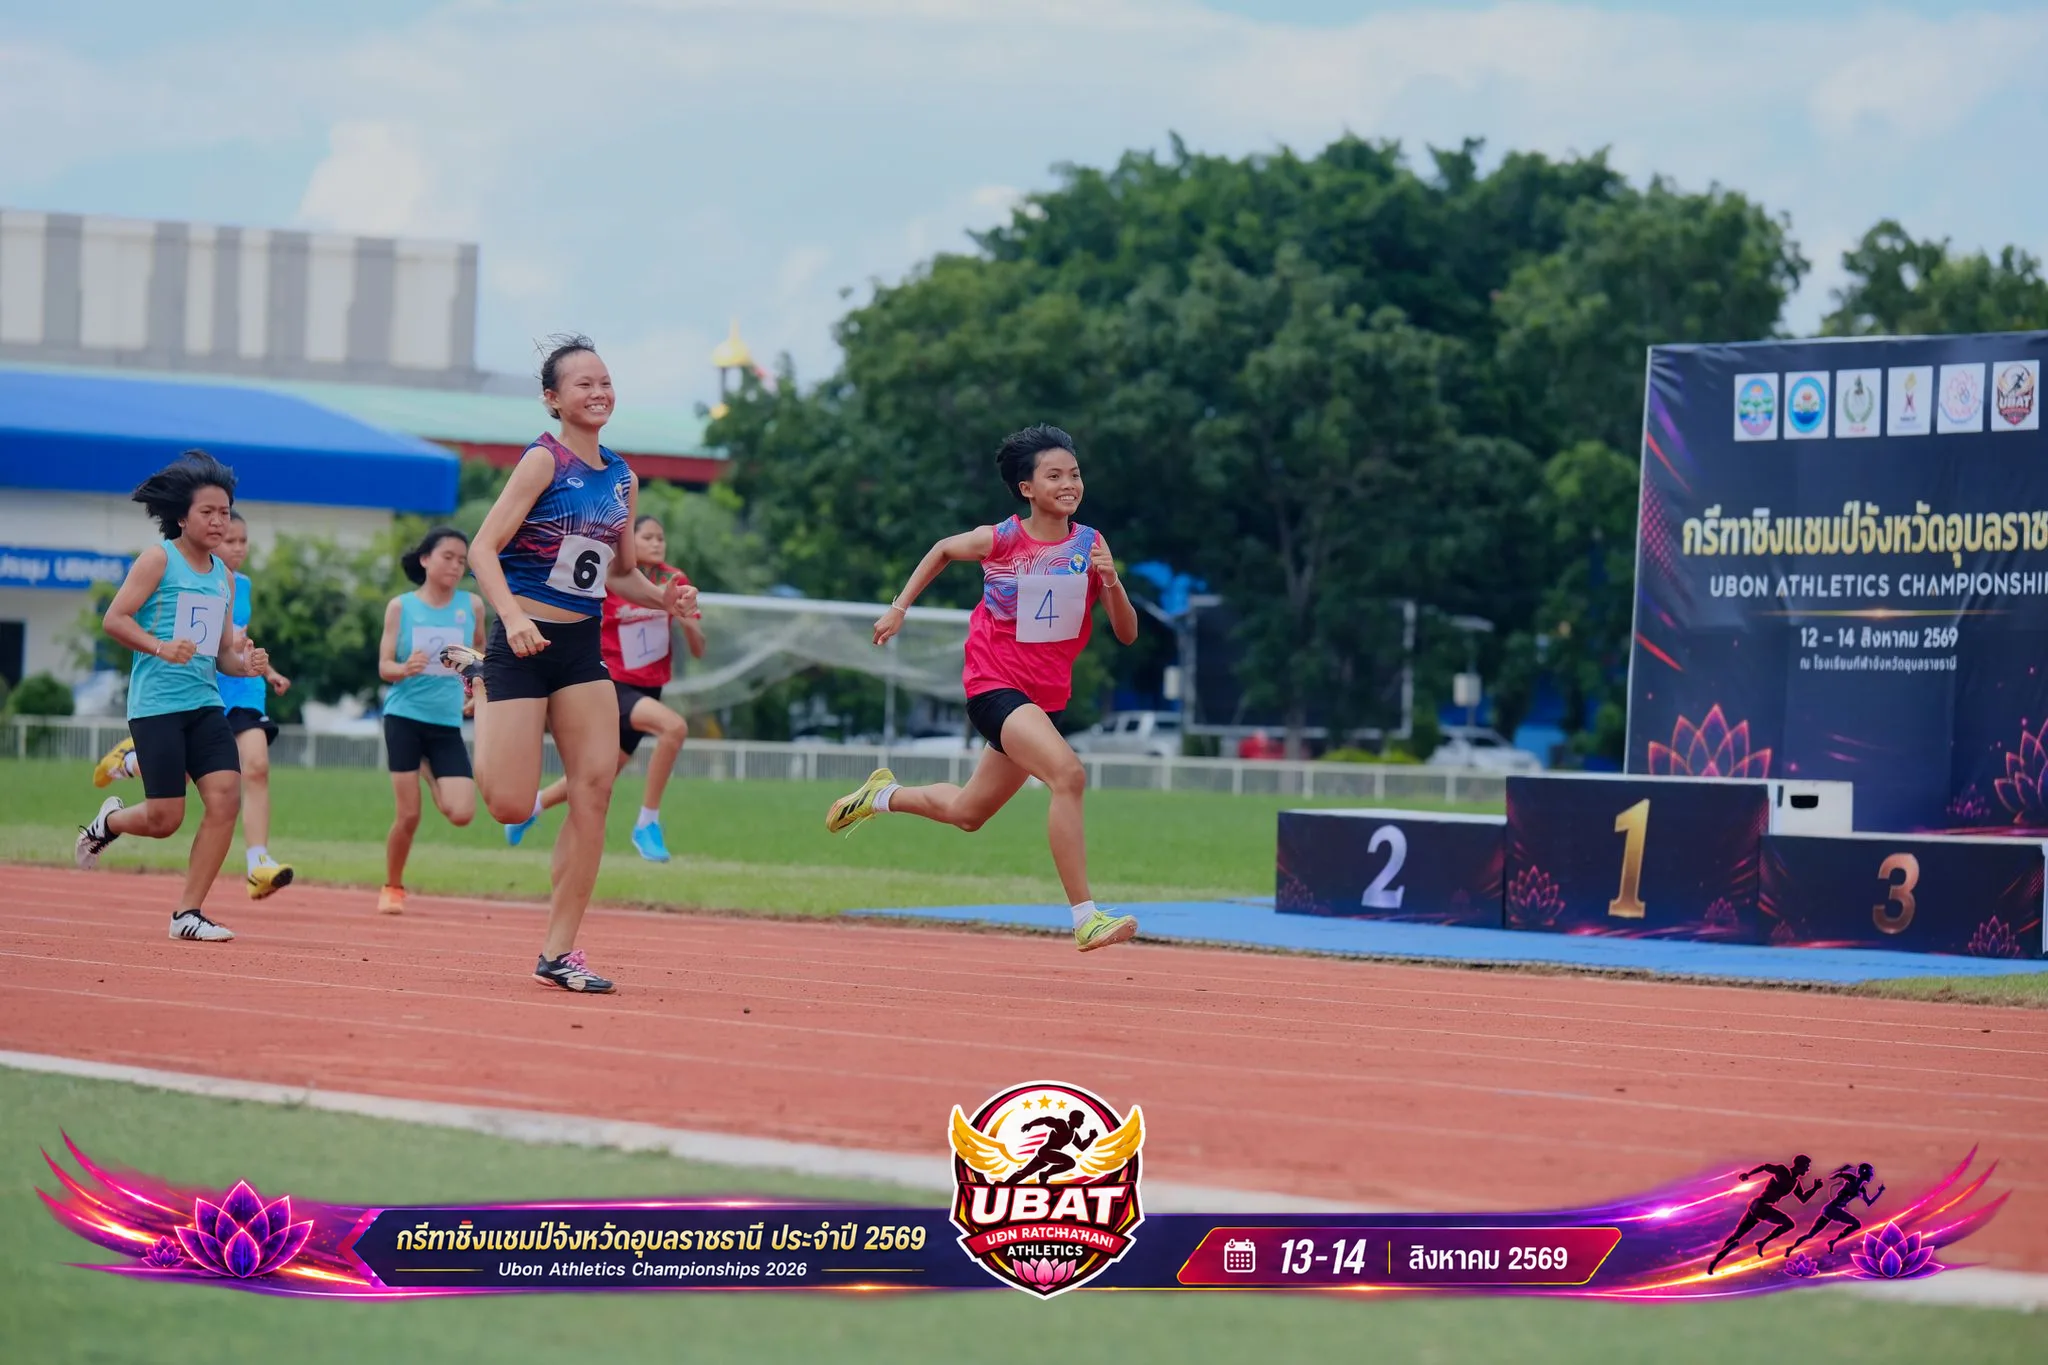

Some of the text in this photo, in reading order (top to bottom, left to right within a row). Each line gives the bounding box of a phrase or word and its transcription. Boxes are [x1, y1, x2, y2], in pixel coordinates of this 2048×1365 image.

[573, 550, 600, 589] 6
[1710, 575, 1768, 597] UBON
[1776, 574, 1890, 597] ATHLETICS
[190, 606, 208, 645] 5
[1034, 588, 1060, 629] 4
[429, 636, 445, 665] 2
[636, 626, 658, 659] 1
[1800, 627, 1818, 648] 12
[1838, 627, 1855, 648] 14
[1860, 626, 1919, 649] สิงหาคม
[1923, 626, 1959, 648] 2569
[1361, 825, 1407, 909] 2
[1608, 799, 1651, 919] 1
[1873, 853, 1920, 935] 3
